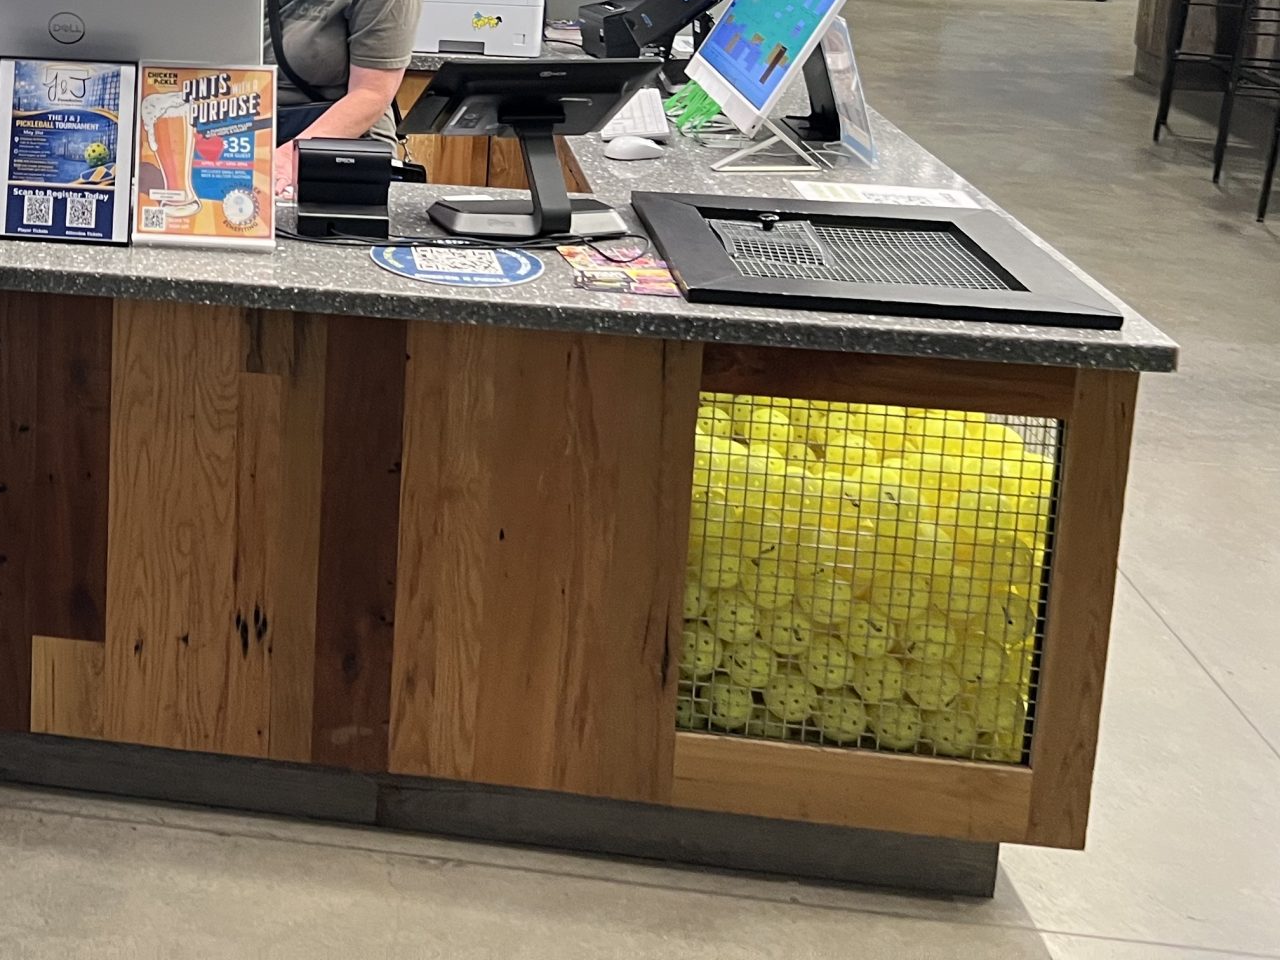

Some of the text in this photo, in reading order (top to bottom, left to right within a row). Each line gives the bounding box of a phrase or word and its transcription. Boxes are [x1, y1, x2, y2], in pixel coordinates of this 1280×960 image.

[52, 23, 82, 33] DELL
[147, 71, 178, 79] CHICKEN
[182, 73, 231, 102] PINTS
[189, 92, 260, 126] PURPOSE
[16, 120, 99, 130] PICKLEBALL TOURNAMENT
[223, 137, 251, 153] $35
[13, 188, 109, 202] Scan to Register Today
